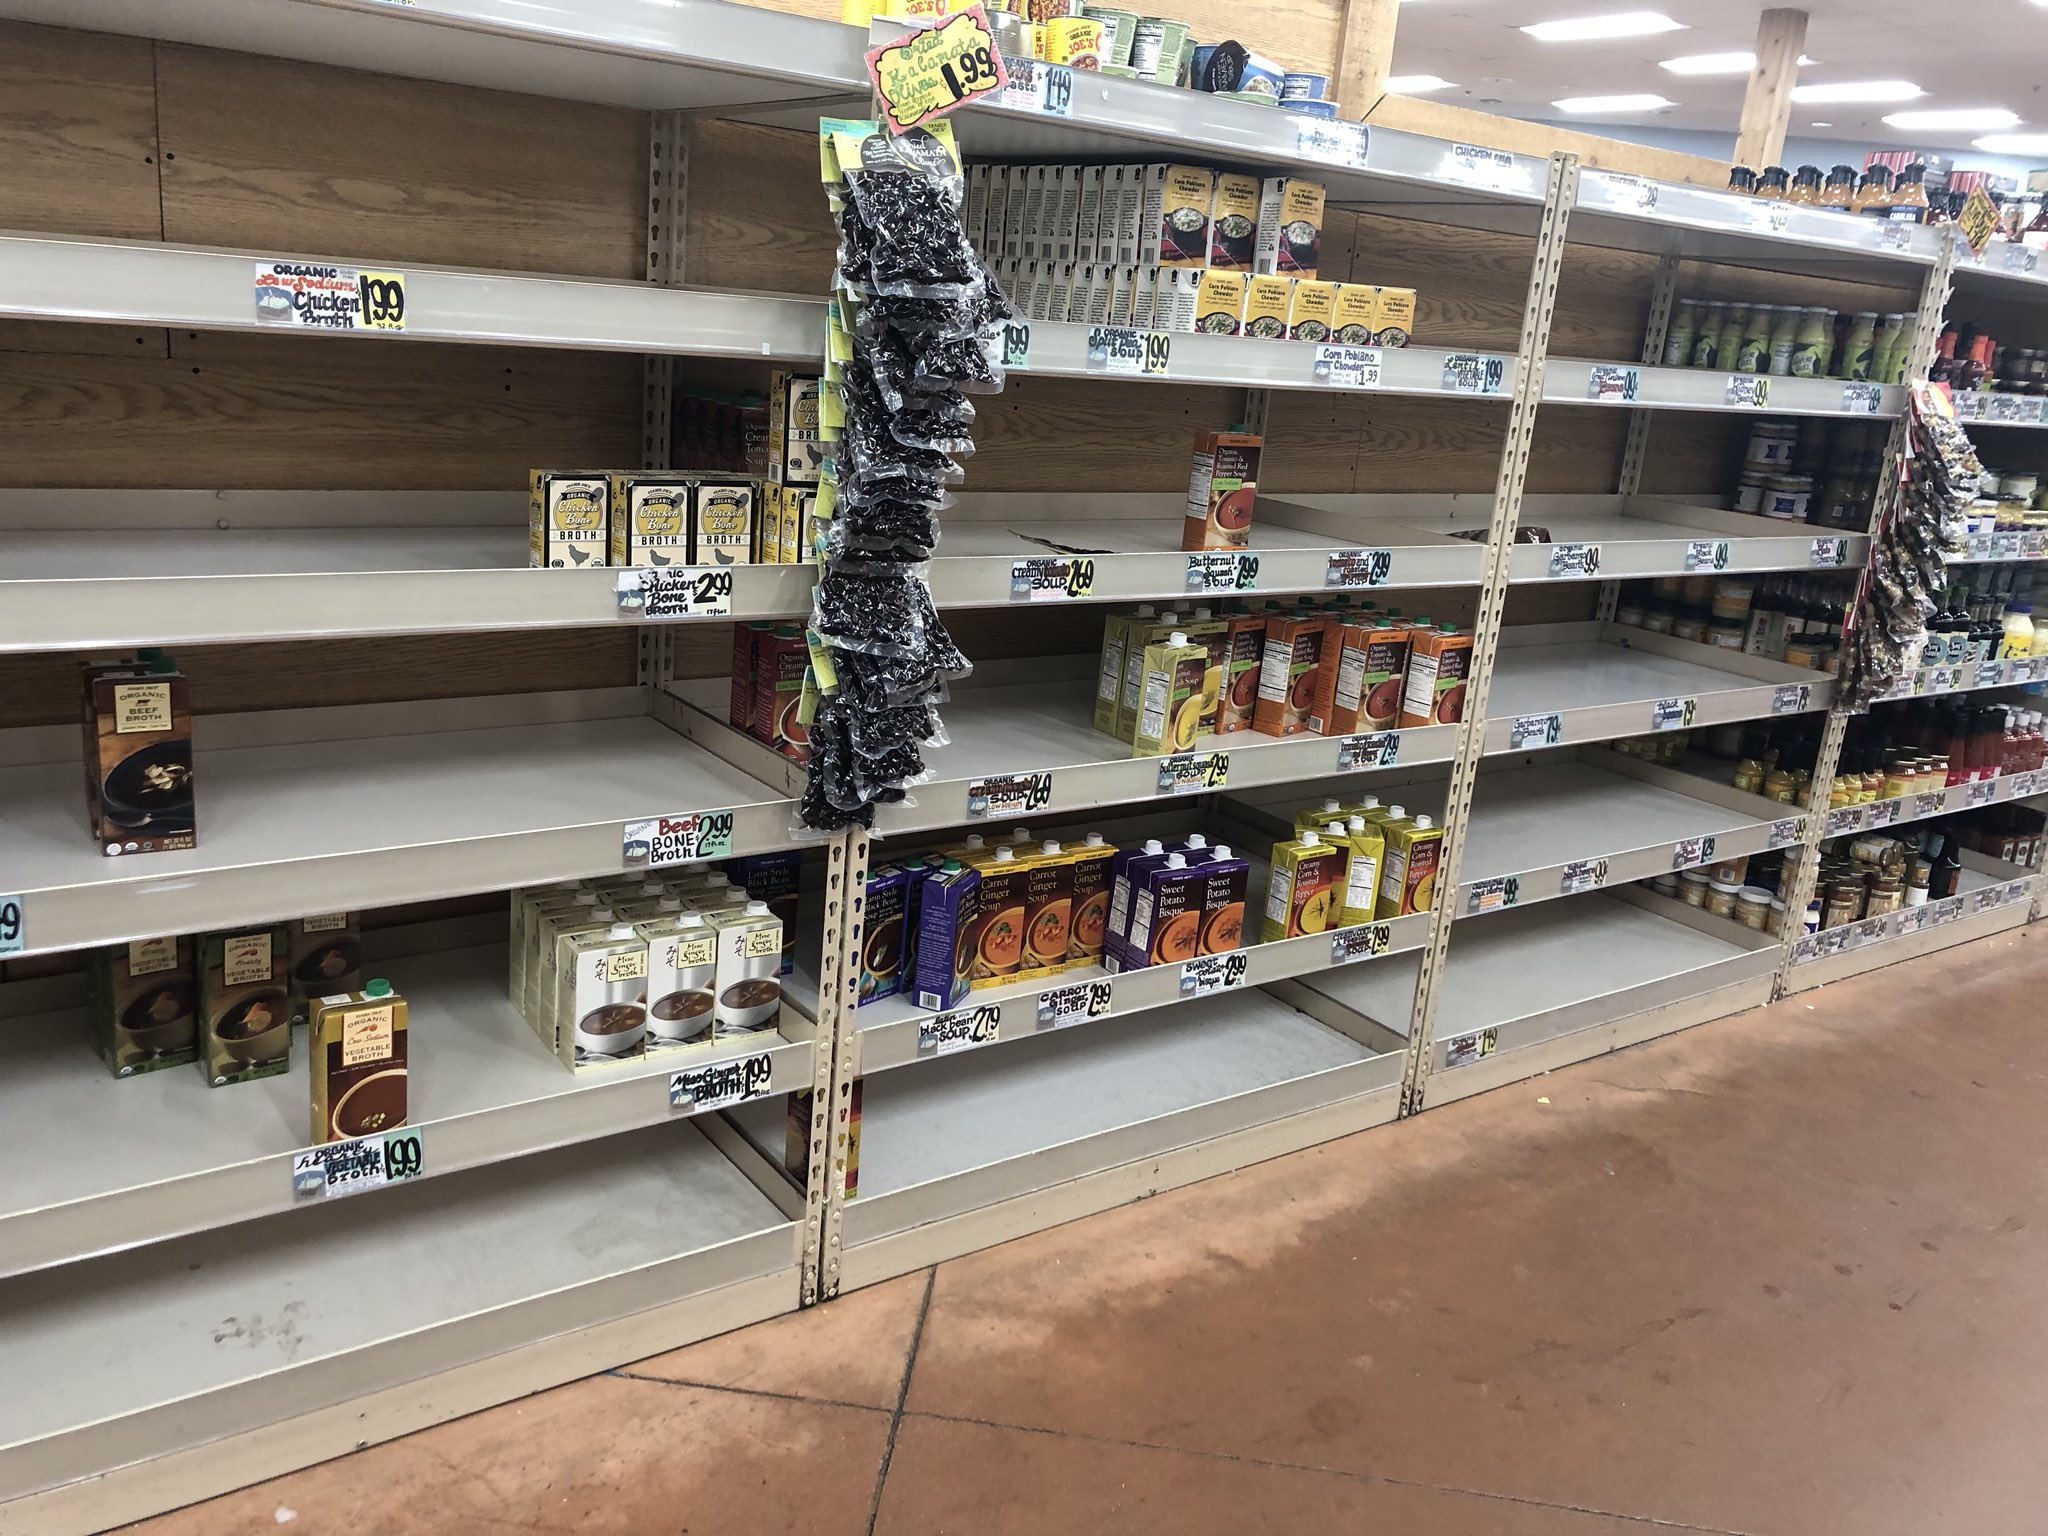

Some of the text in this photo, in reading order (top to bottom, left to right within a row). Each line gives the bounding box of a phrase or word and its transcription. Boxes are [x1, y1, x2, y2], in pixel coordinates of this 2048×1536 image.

[1068, 38, 1095, 55] JOE'S
[273, 264, 338, 278] ORGANIC
[292, 291, 361, 313] Chicken
[300, 310, 355, 329] Broth
[1104, 328, 1137, 338] ORGANIC
[1323, 347, 1375, 363] Corn Poblano
[1333, 359, 1365, 371] Chowder
[1237, 462, 1248, 470] Red
[567, 491, 591, 500] ORGANIC
[558, 500, 599, 513] Chicken
[713, 498, 737, 506] ORGANIC
[640, 505, 679, 518] Chicken
[705, 505, 743, 518] Chicken
[565, 513, 592, 526] Bone
[647, 518, 674, 531] Bone
[712, 518, 738, 531] Bone
[559, 530, 597, 541] BROTH
[641, 536, 678, 546] BROTH
[706, 535, 741, 545] BROTH
[1026, 558, 1057, 568] ORGANIC
[1188, 554, 1235, 569] Butternut
[639, 578, 699, 593] Chicken
[1031, 577, 1067, 590] SOUP
[648, 592, 687, 606] Bone
[645, 604, 689, 616] BROTH
[120, 691, 166, 701] ORGANIC
[129, 706, 159, 715] BEEF
[126, 714, 162, 722] BROTH
[983, 776, 1015, 786] ORGANIC
[990, 791, 1026, 804] SOUP
[659, 814, 701, 836] Beef
[652, 832, 695, 850] BONE
[1412, 842, 1435, 853] Creamy
[651, 847, 694, 864] Broth
[1411, 850, 1426, 861] Corn
[1075, 862, 1101, 873] Carrot
[1298, 860, 1321, 872] Creamy
[1410, 858, 1432, 870] Roasted
[1029, 870, 1057, 881] Carrot
[1074, 873, 1102, 885] Ginger
[1297, 870, 1313, 880] Corn
[1408, 868, 1428, 880] Pepper
[981, 878, 1009, 890] Carrot
[1028, 881, 1058, 893] Ginger
[1207, 877, 1231, 889] Sweet
[1296, 876, 1319, 889] Roasted
[980, 889, 1010, 902] Ginger
[1073, 885, 1094, 896] Soup
[1160, 884, 1185, 896] Sweet
[1206, 888, 1231, 900] Potato
[1294, 888, 1315, 900] Pepper
[1027, 893, 1049, 905] Soup
[1160, 896, 1186, 908] Potato
[1205, 898, 1230, 911] Bisque
[979, 902, 1001, 913] Soup
[1158, 906, 1185, 919] Bisque
[754, 932, 770, 940] Miso
[228, 942, 268, 952] ORGANIC
[687, 943, 704, 951] Miso
[755, 946, 774, 954] broth
[617, 955, 634, 964] Miso
[688, 956, 707, 965] broth
[226, 967, 271, 977] VEGETABLE
[233, 974, 265, 982] BROTH
[618, 969, 638, 978] broth
[1040, 984, 1089, 1003] CARROT
[1056, 1001, 1087, 1016] SOUP
[347, 1017, 388, 1028] ORGANIC
[920, 1017, 974, 1038] black bean
[346, 1033, 389, 1046] Low Sodium
[938, 1026, 970, 1043] SOUP
[344, 1043, 391, 1057] VEGETABLE
[351, 1051, 384, 1062] BROTH
[694, 1078, 741, 1103] BROTH
[314, 1140, 365, 1158] ORGANIC
[327, 1165, 380, 1186] broth
